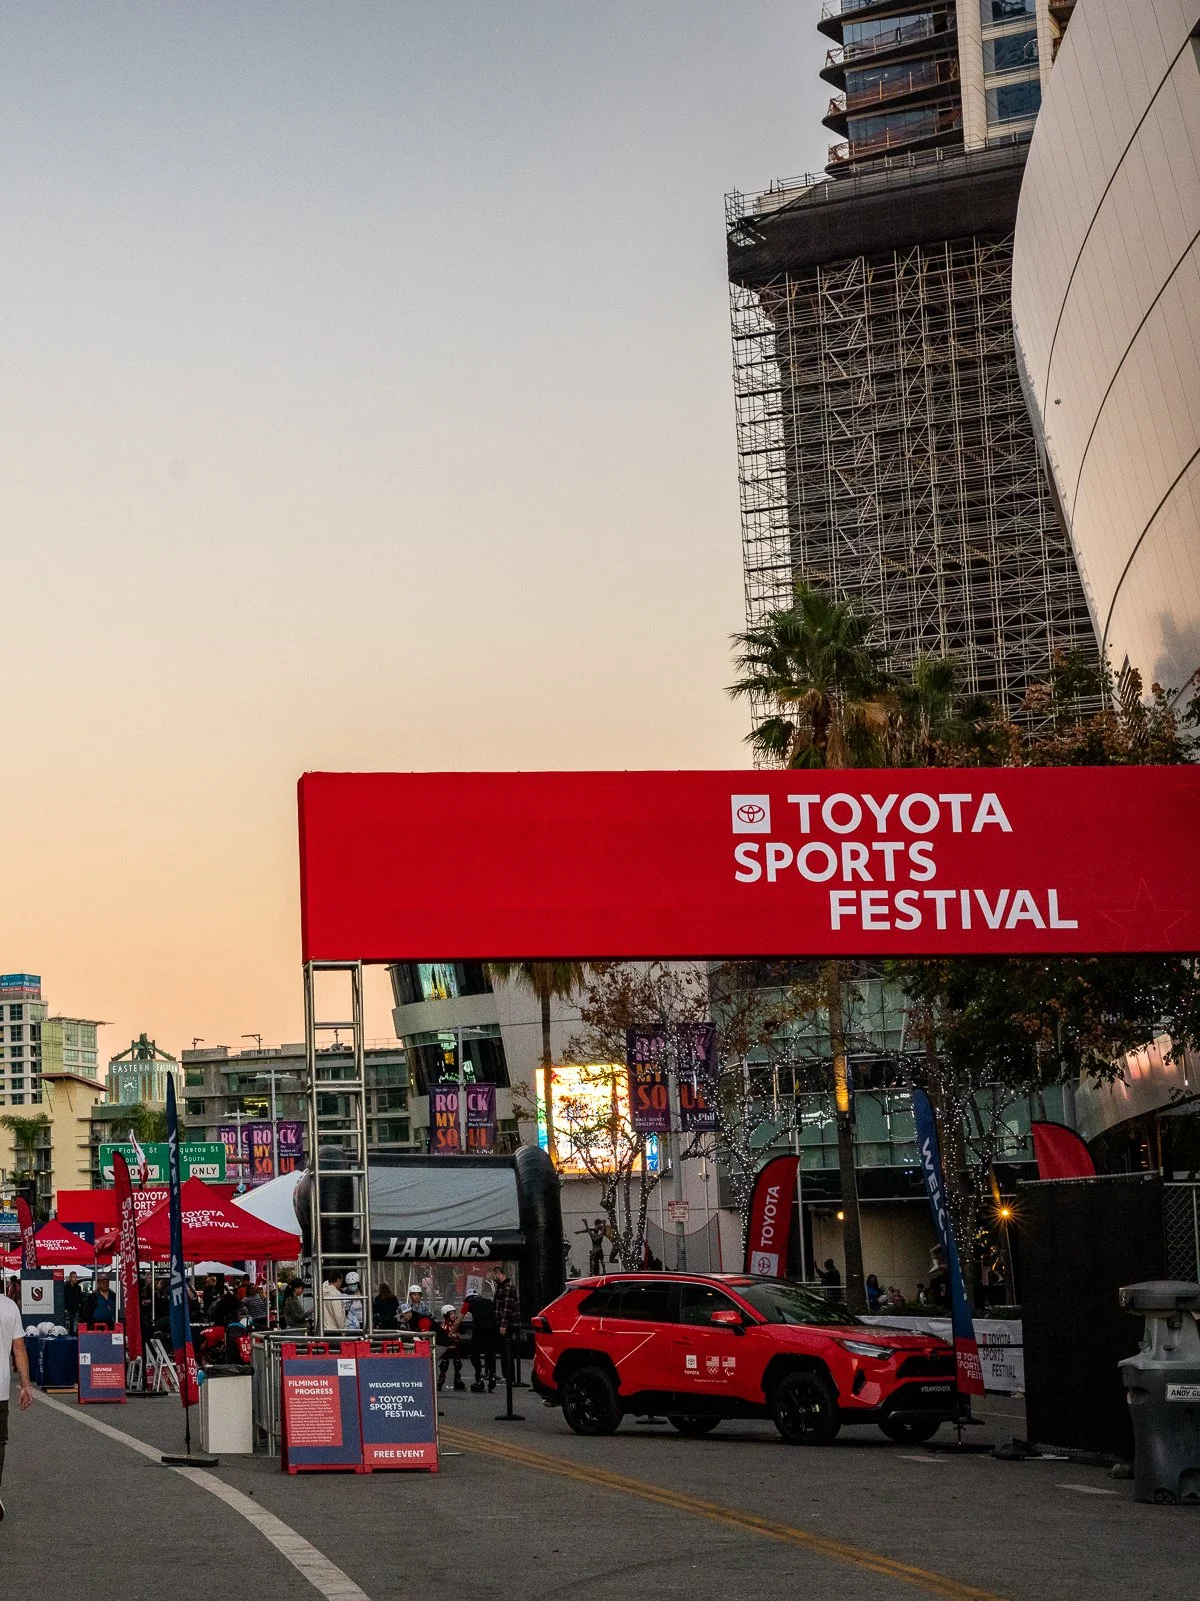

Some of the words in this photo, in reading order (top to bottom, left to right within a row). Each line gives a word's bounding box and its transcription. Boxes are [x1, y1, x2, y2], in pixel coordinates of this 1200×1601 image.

[788, 793, 1013, 834] TOYOTA
[733, 841, 936, 884] SPORTS
[830, 890, 1079, 930] FESTIVAL
[112, 1064, 150, 1073] EASTERN
[156, 1064, 178, 1072] EASTERN
[436, 1113, 455, 1126] MY
[699, 1112, 714, 1120] Phil
[254, 1145, 270, 1157] MY
[133, 1192, 168, 1200] TOYOTA
[134, 1201, 156, 1210] ORT
[761, 1186, 780, 1246] TOYOTA
[122, 1202, 131, 1263] SPORTS
[129, 1214, 138, 1285] TOYOTA
[386, 1238, 418, 1257] LA
[420, 1237, 493, 1259] KINGS
[988, 1334, 1010, 1344] TOYOTA
[963, 1353, 979, 1362] TOYO
[983, 1348, 1004, 1361] SPORTS
[967, 1370, 981, 1379] FEST
[992, 1364, 1016, 1378] FESTIVAL
